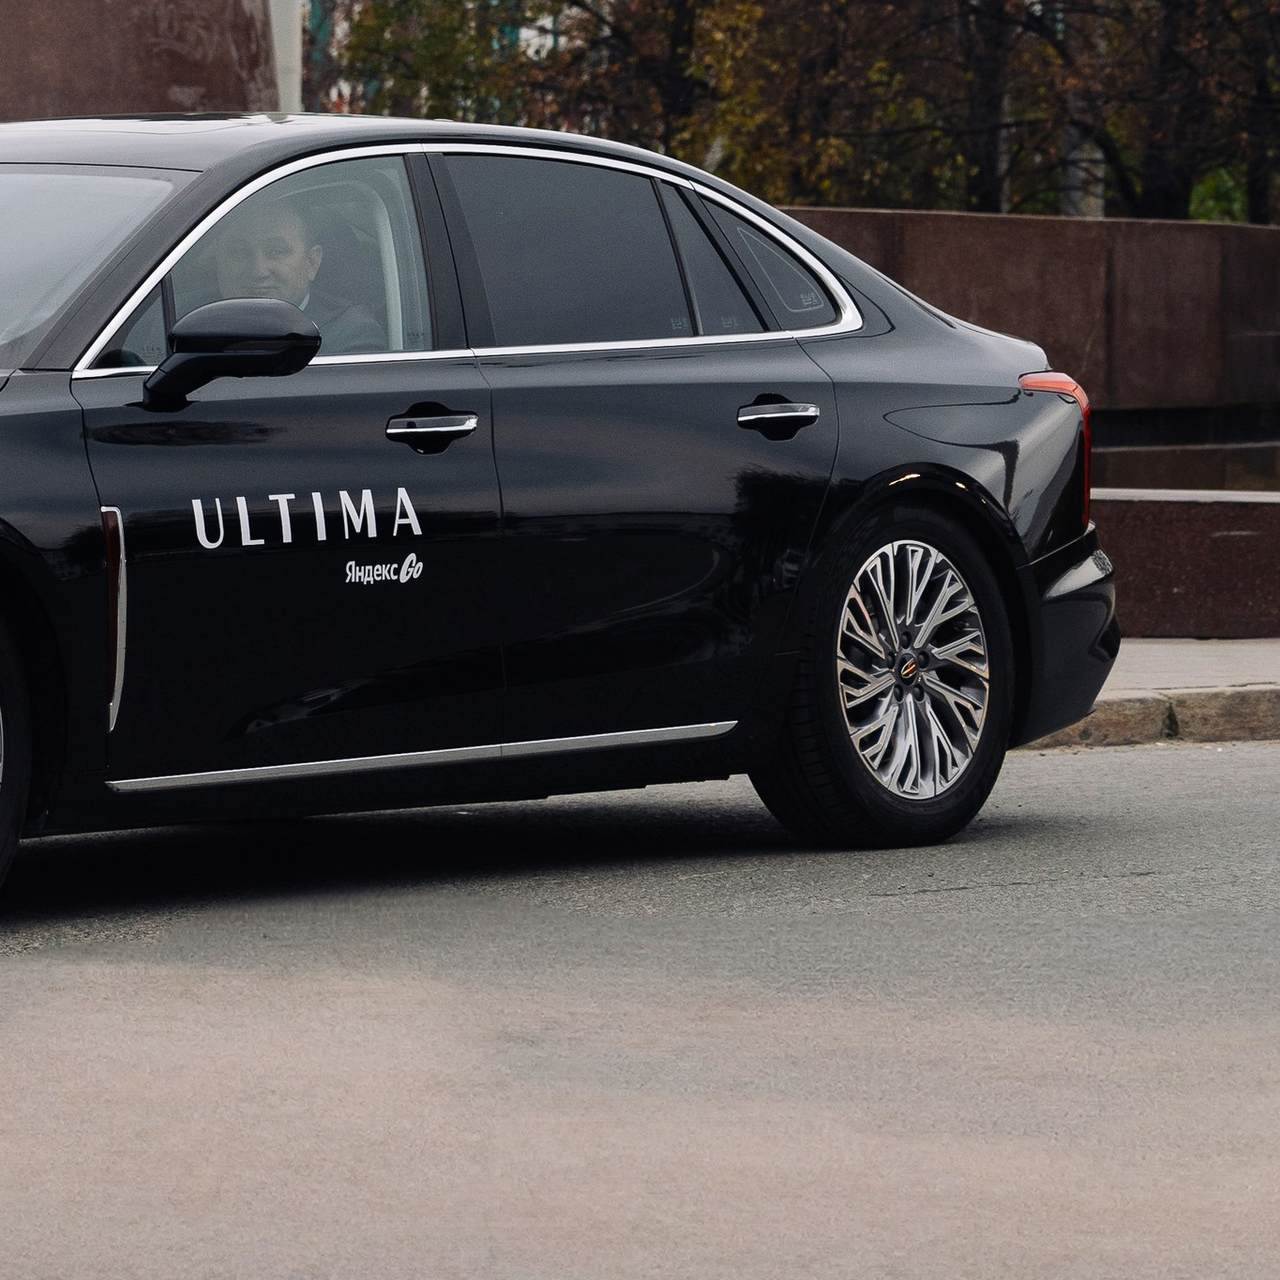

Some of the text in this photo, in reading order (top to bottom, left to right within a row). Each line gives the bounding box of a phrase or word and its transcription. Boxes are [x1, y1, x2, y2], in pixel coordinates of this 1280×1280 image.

[191, 487, 422, 549] ULTIMA
[345, 552, 424, 585] Яндекс Go
